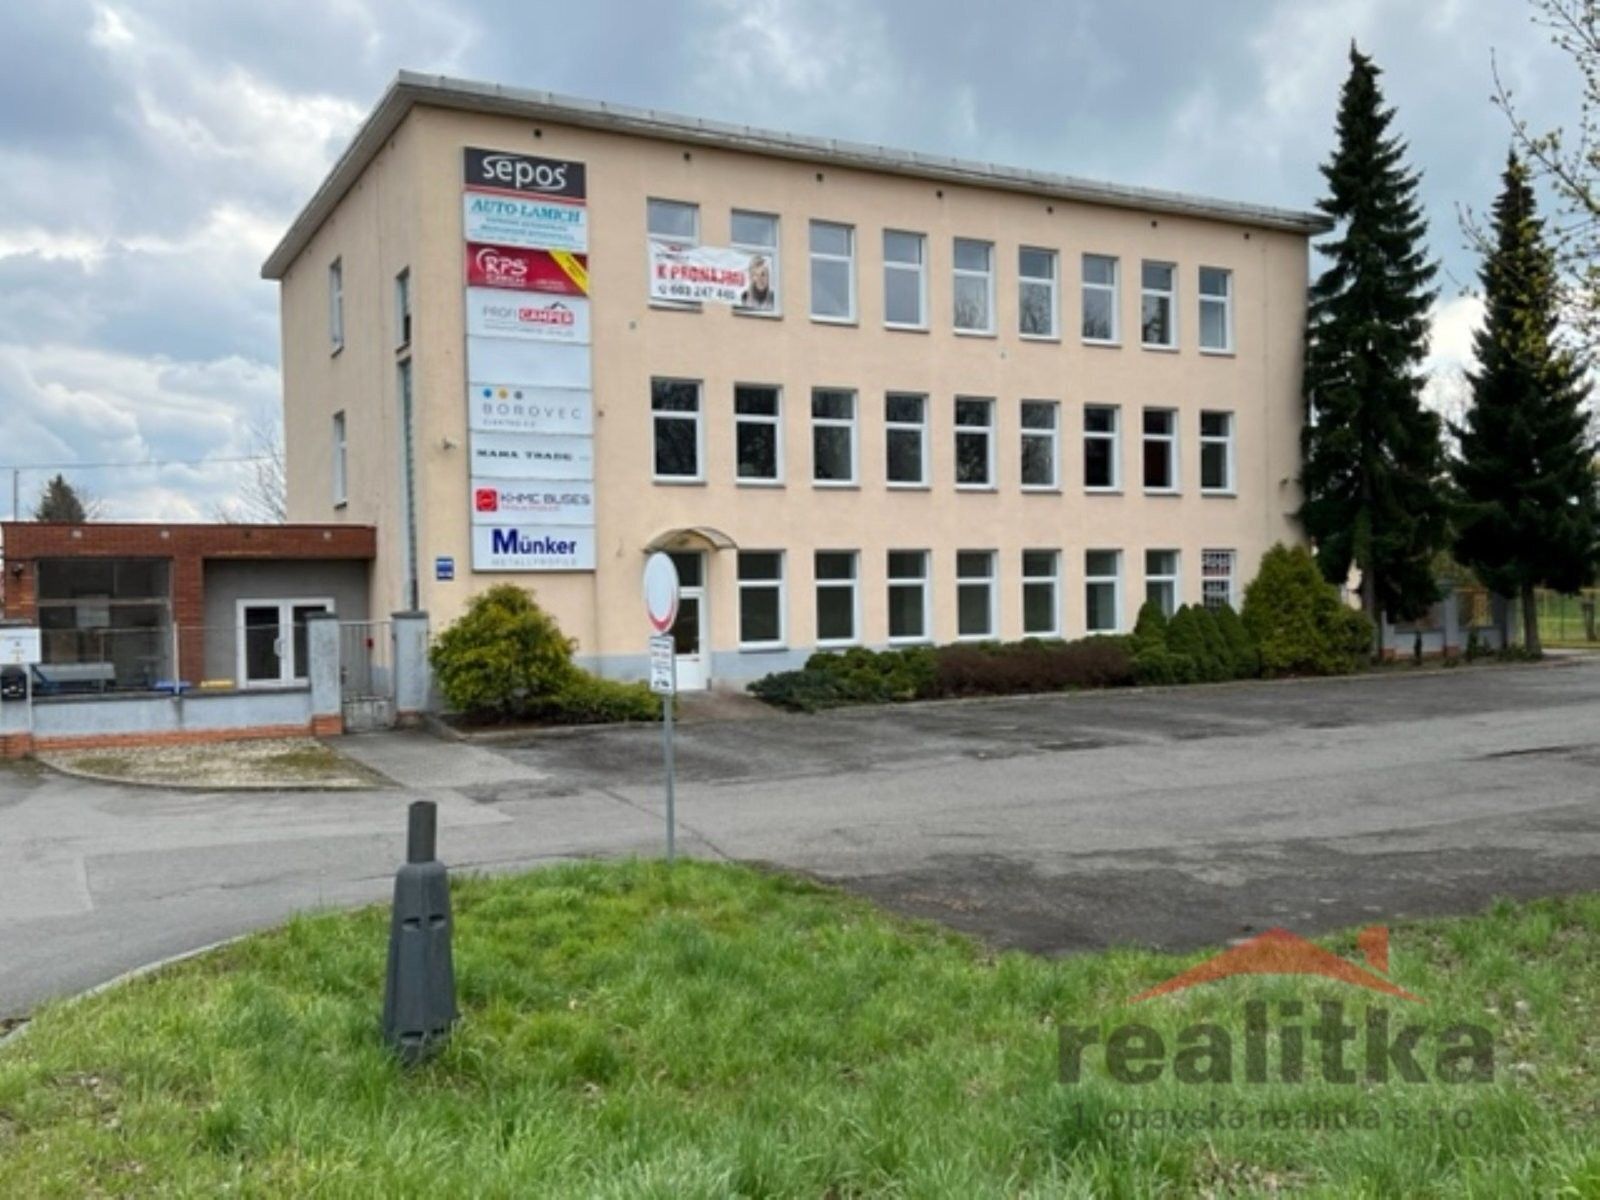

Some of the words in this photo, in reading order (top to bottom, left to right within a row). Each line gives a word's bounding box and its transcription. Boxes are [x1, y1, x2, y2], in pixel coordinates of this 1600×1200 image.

[482, 155, 568, 191] sepos
[471, 198, 517, 216] AUTO
[482, 402, 582, 420] BOROVEC
[492, 528, 577, 555] Münker
